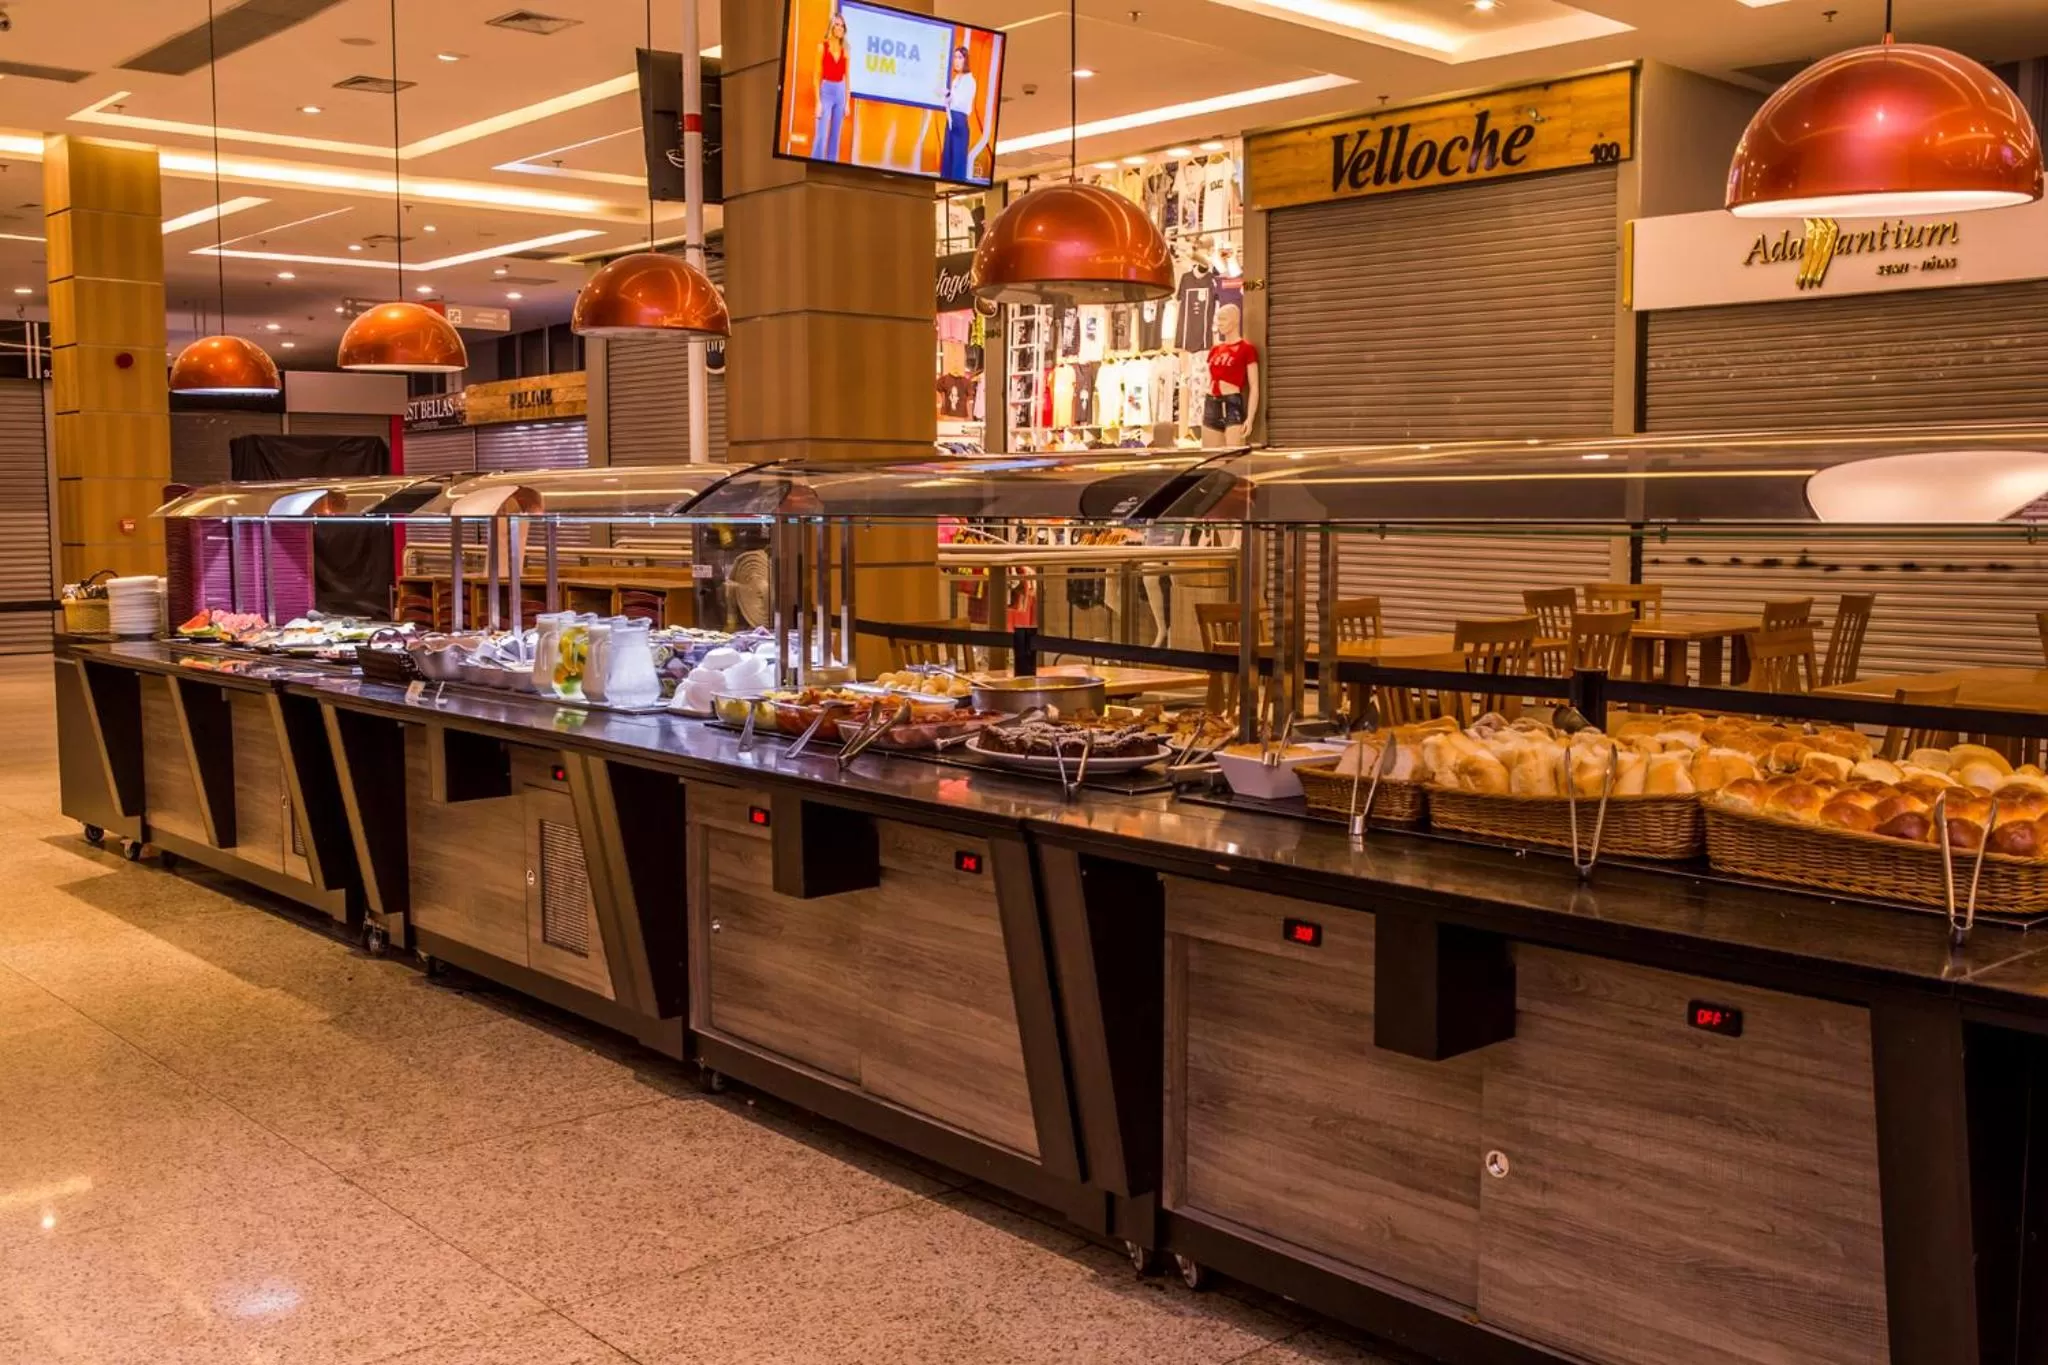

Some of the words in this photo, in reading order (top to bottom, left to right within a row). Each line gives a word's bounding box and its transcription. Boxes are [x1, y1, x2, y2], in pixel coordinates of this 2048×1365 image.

[867, 36, 921, 62] HORA
[865, 55, 896, 75] UM
[1332, 109, 1535, 192] Velloche
[1590, 141, 1621, 164] 100
[936, 268, 970, 302] tage
[420, 398, 455, 419] BELLAS
